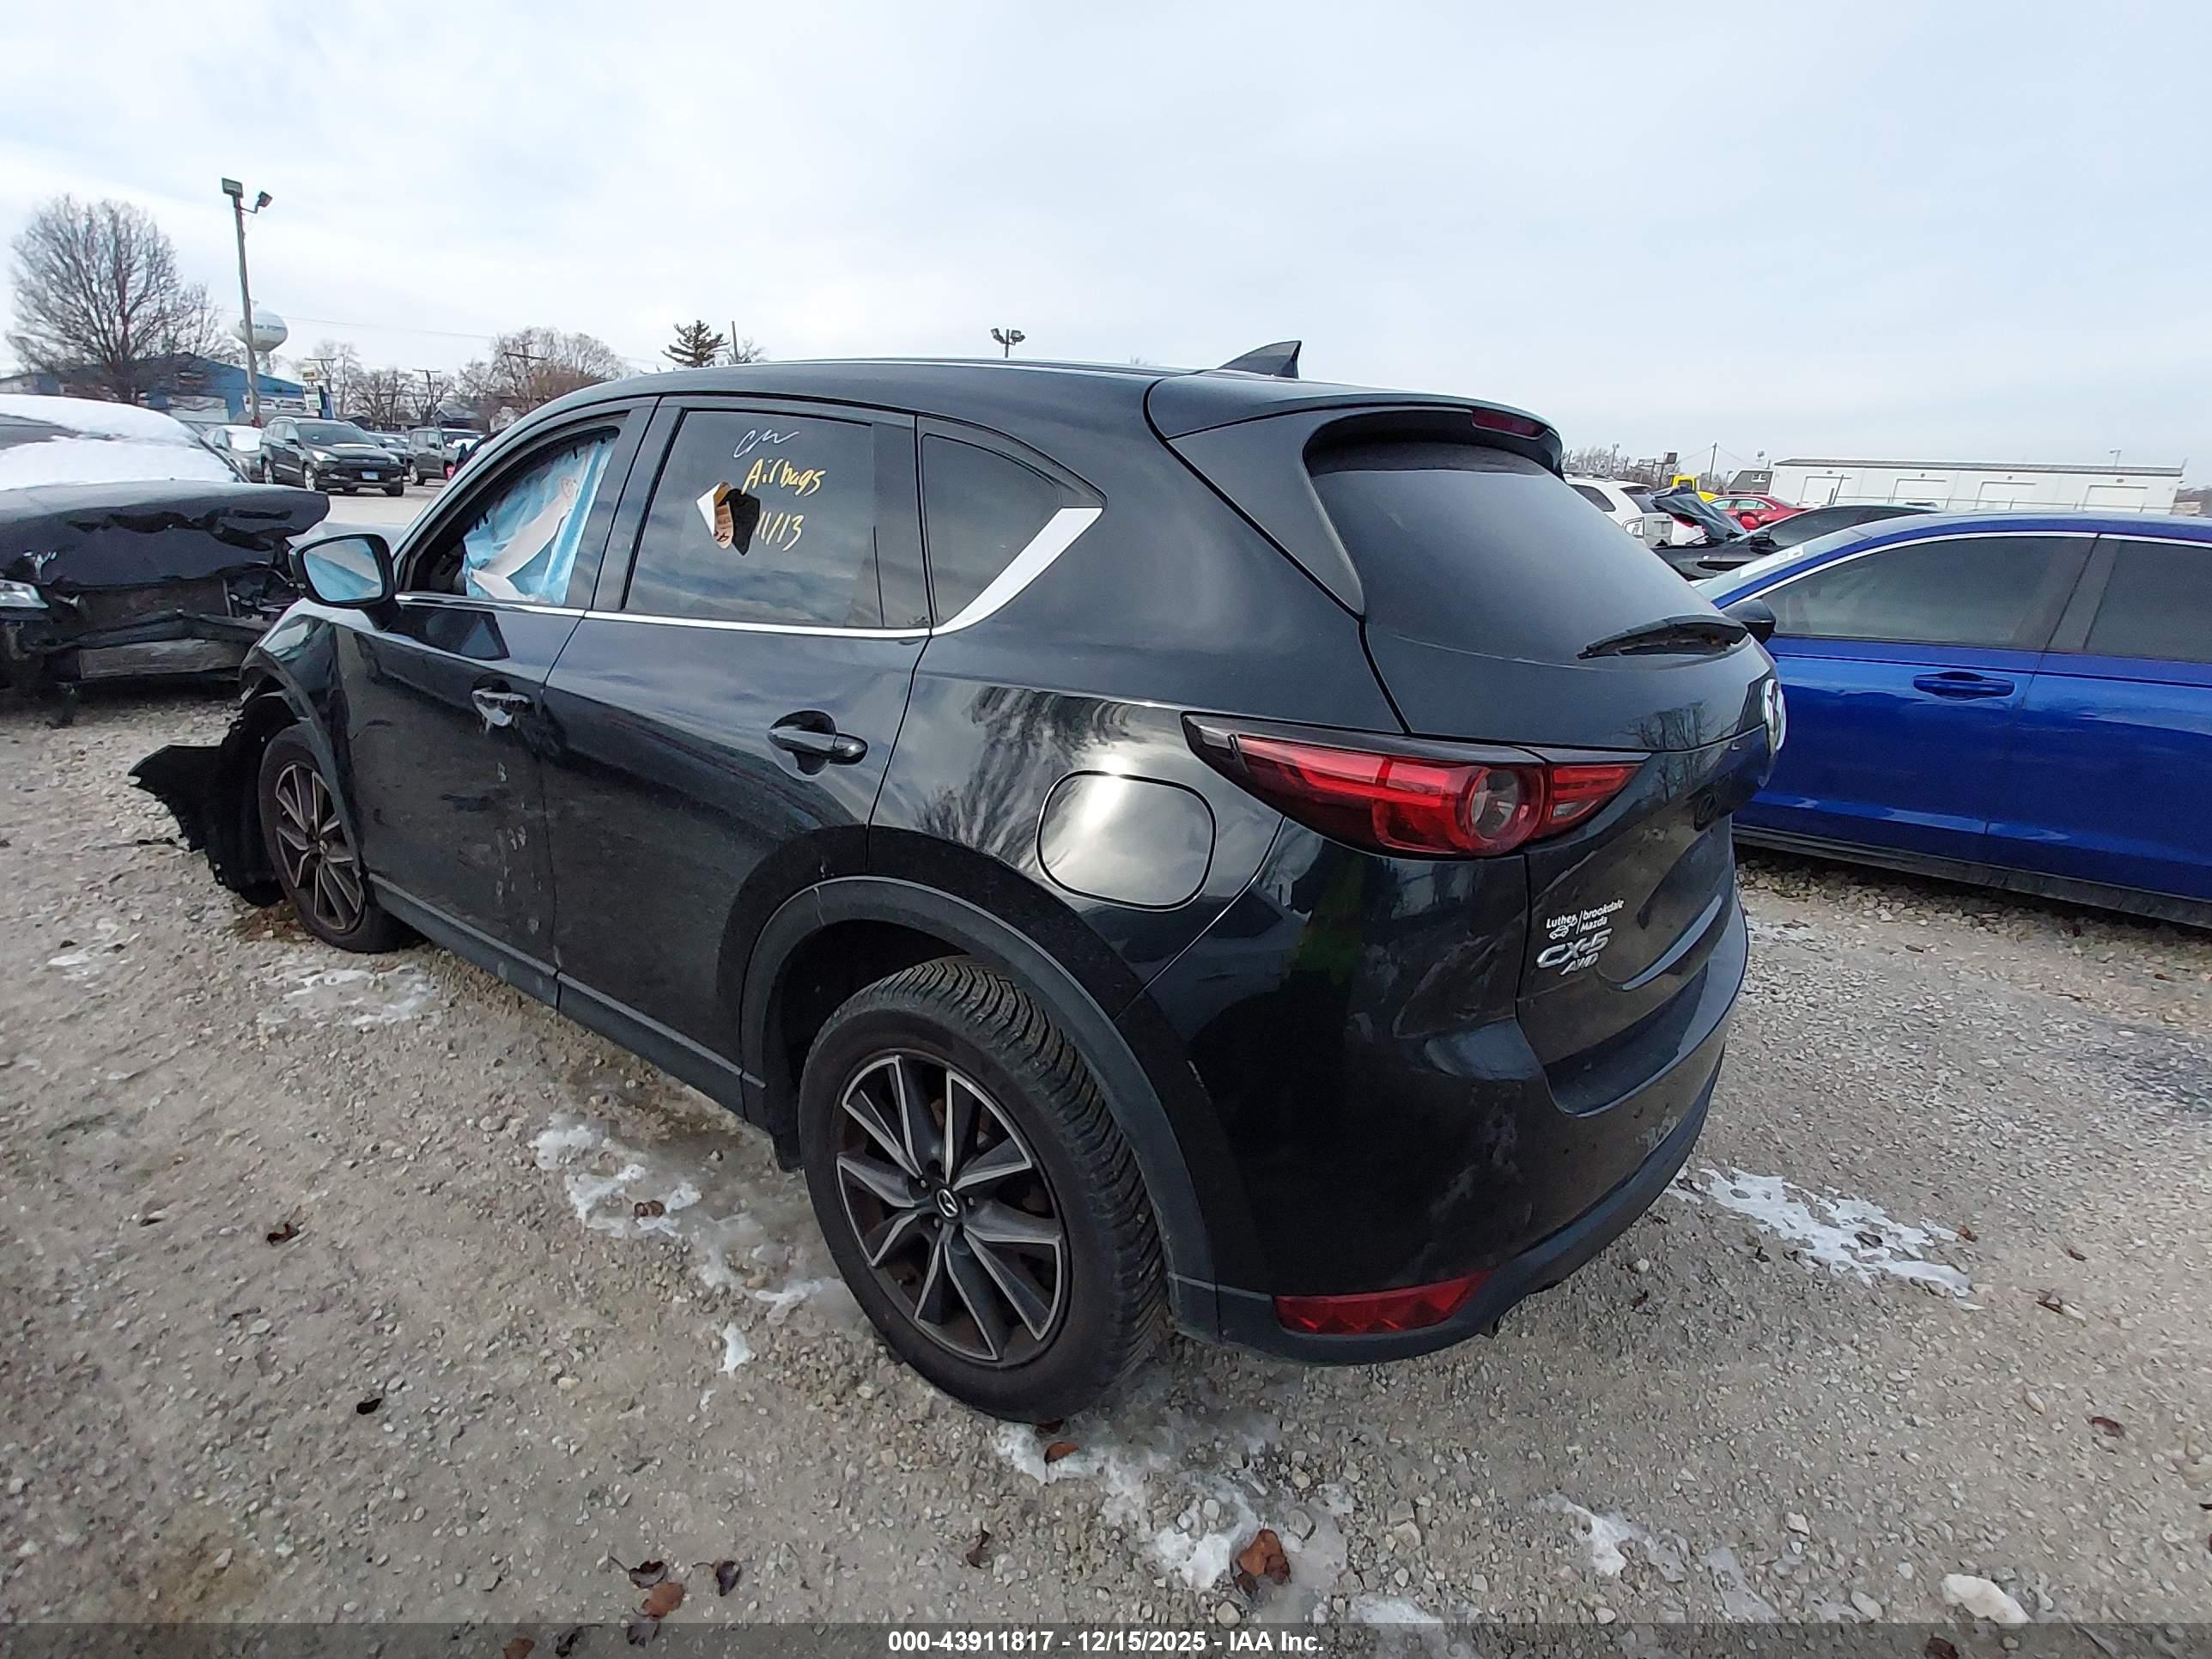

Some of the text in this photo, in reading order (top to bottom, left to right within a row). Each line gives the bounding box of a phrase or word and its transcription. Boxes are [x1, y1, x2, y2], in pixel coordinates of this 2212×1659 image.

[740, 458, 826, 496] Airbags
[1536, 927, 1613, 969] CX-5
[1559, 952, 1599, 976] AWD
